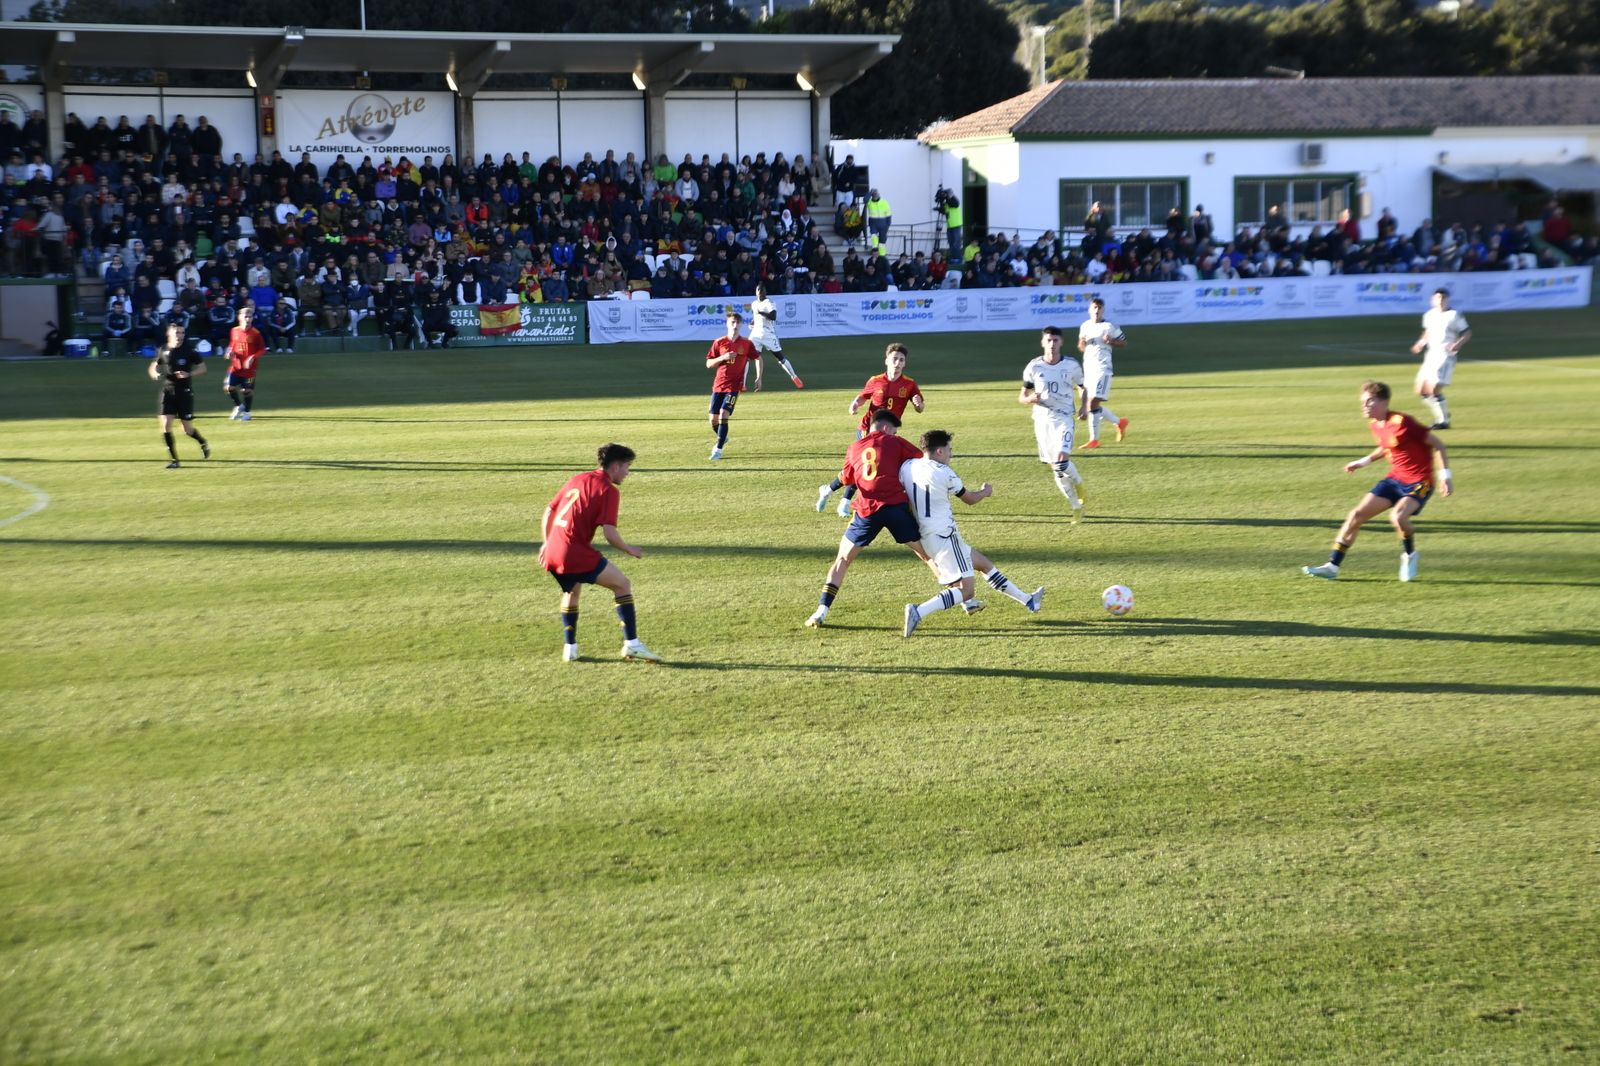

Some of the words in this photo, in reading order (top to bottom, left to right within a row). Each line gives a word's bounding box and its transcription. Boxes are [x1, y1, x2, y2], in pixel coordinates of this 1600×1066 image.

[315, 96, 426, 140] Atrévete
[289, 145, 303, 153] LA
[305, 145, 364, 153] CARIHUELA
[372, 145, 451, 154] TORREMOLINOS
[450, 310, 475, 318] OTEL
[450, 318, 481, 327] ESPAD
[1048, 381, 1059, 394] 10
[887, 397, 894, 410] 9
[861, 447, 878, 481] 8
[912, 482, 931, 518] 11
[553, 488, 580, 528] 2
